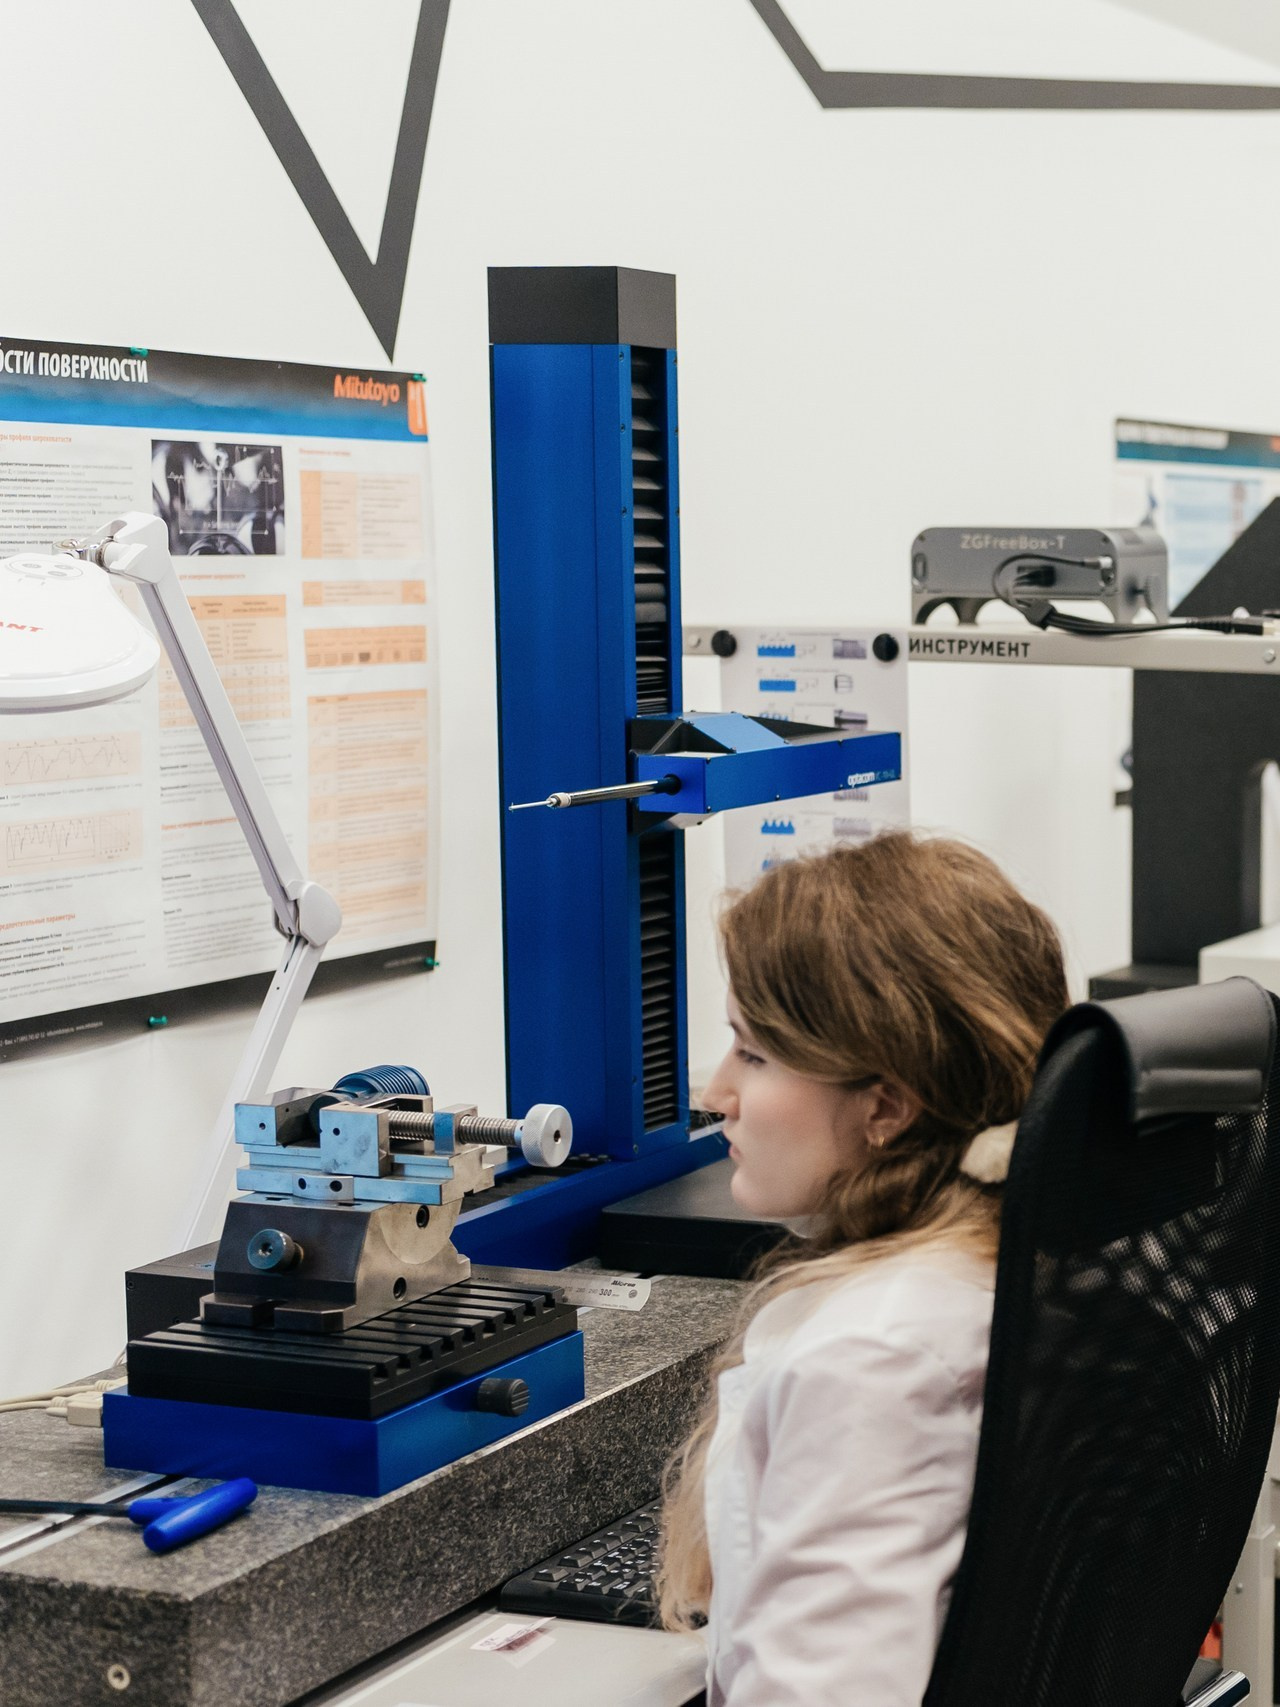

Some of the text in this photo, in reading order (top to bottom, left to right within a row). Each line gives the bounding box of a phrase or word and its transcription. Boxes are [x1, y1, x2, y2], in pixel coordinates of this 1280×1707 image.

[38, 352, 149, 383] ПОВЕРХНОСТИ
[334, 374, 400, 407] Mitutoyo
[960, 534, 1066, 550] ZGFreeBox-T
[909, 639, 1031, 658] ИНСТРУМЕНТ
[599, 1288, 612, 1297] 300
